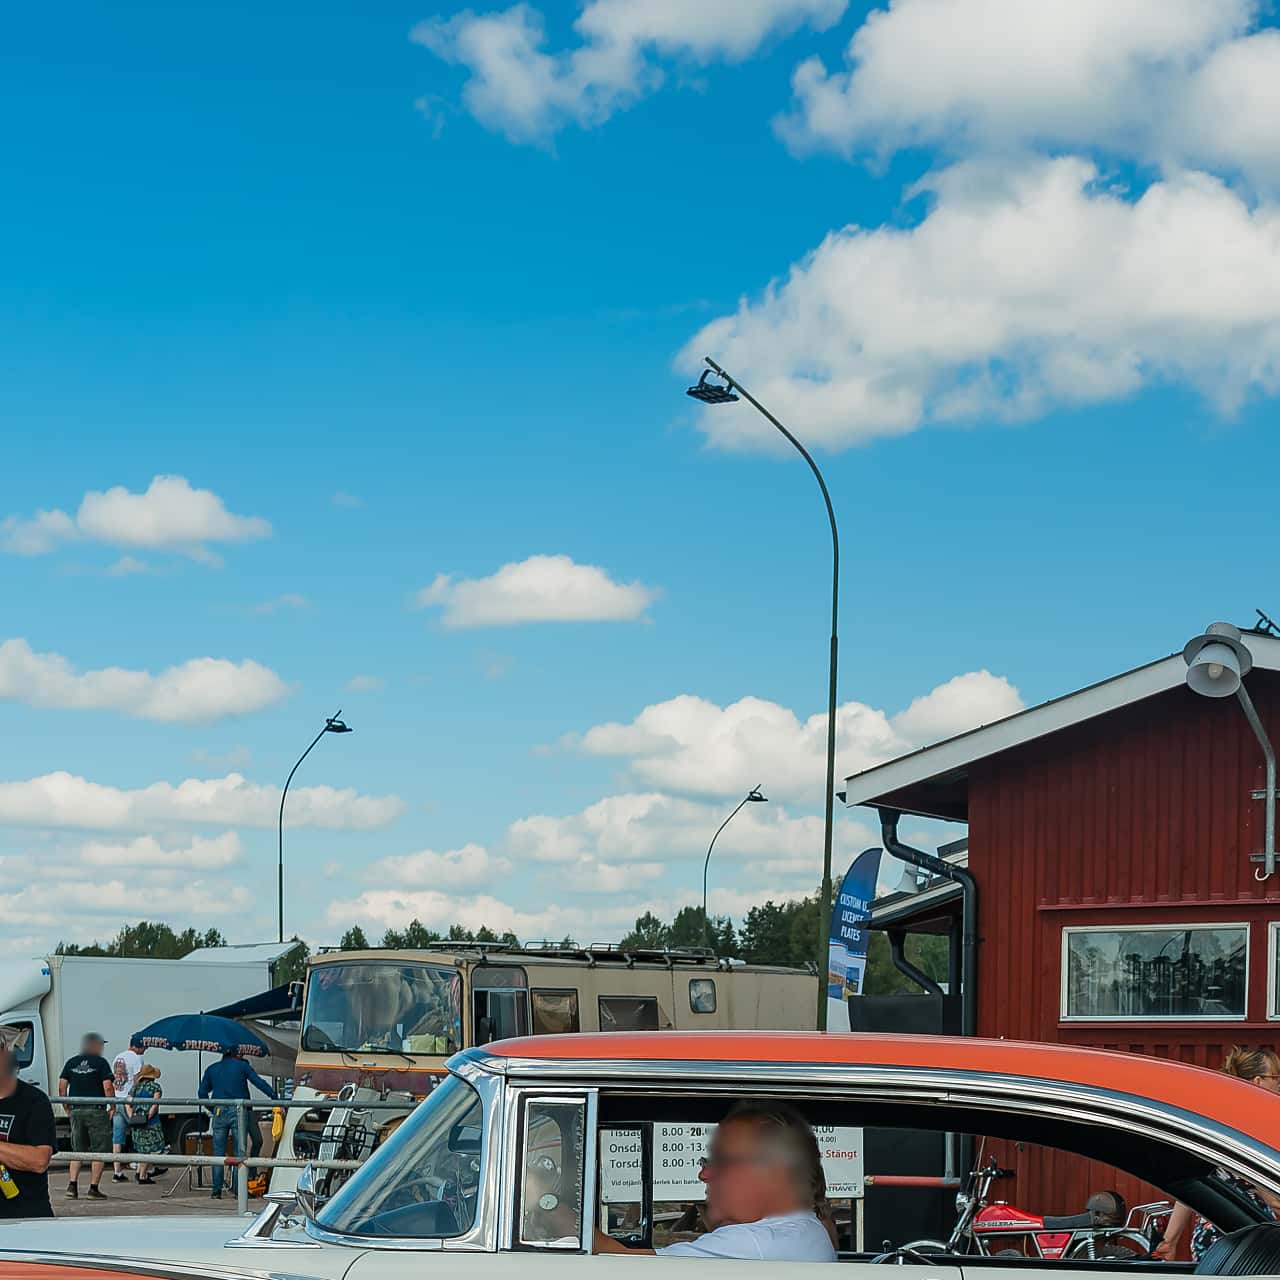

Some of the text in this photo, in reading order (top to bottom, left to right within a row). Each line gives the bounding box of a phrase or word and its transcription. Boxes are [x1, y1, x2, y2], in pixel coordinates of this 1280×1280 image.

[840, 893, 869, 912] CUSTOM U
[841, 925, 861, 941] PLATES
[142, 1037, 167, 1048] PRIPPS
[185, 1040, 219, 1050] PRIPPS
[238, 1044, 260, 1055] PRIPPS
[662, 1127, 683, 1136] 8.00
[609, 1143, 642, 1153] Onsda
[662, 1143, 684, 1152] 8.00
[825, 1149, 857, 1160] Stängt
[609, 1159, 641, 1169] Torsd
[662, 1159, 684, 1168] 8.00
